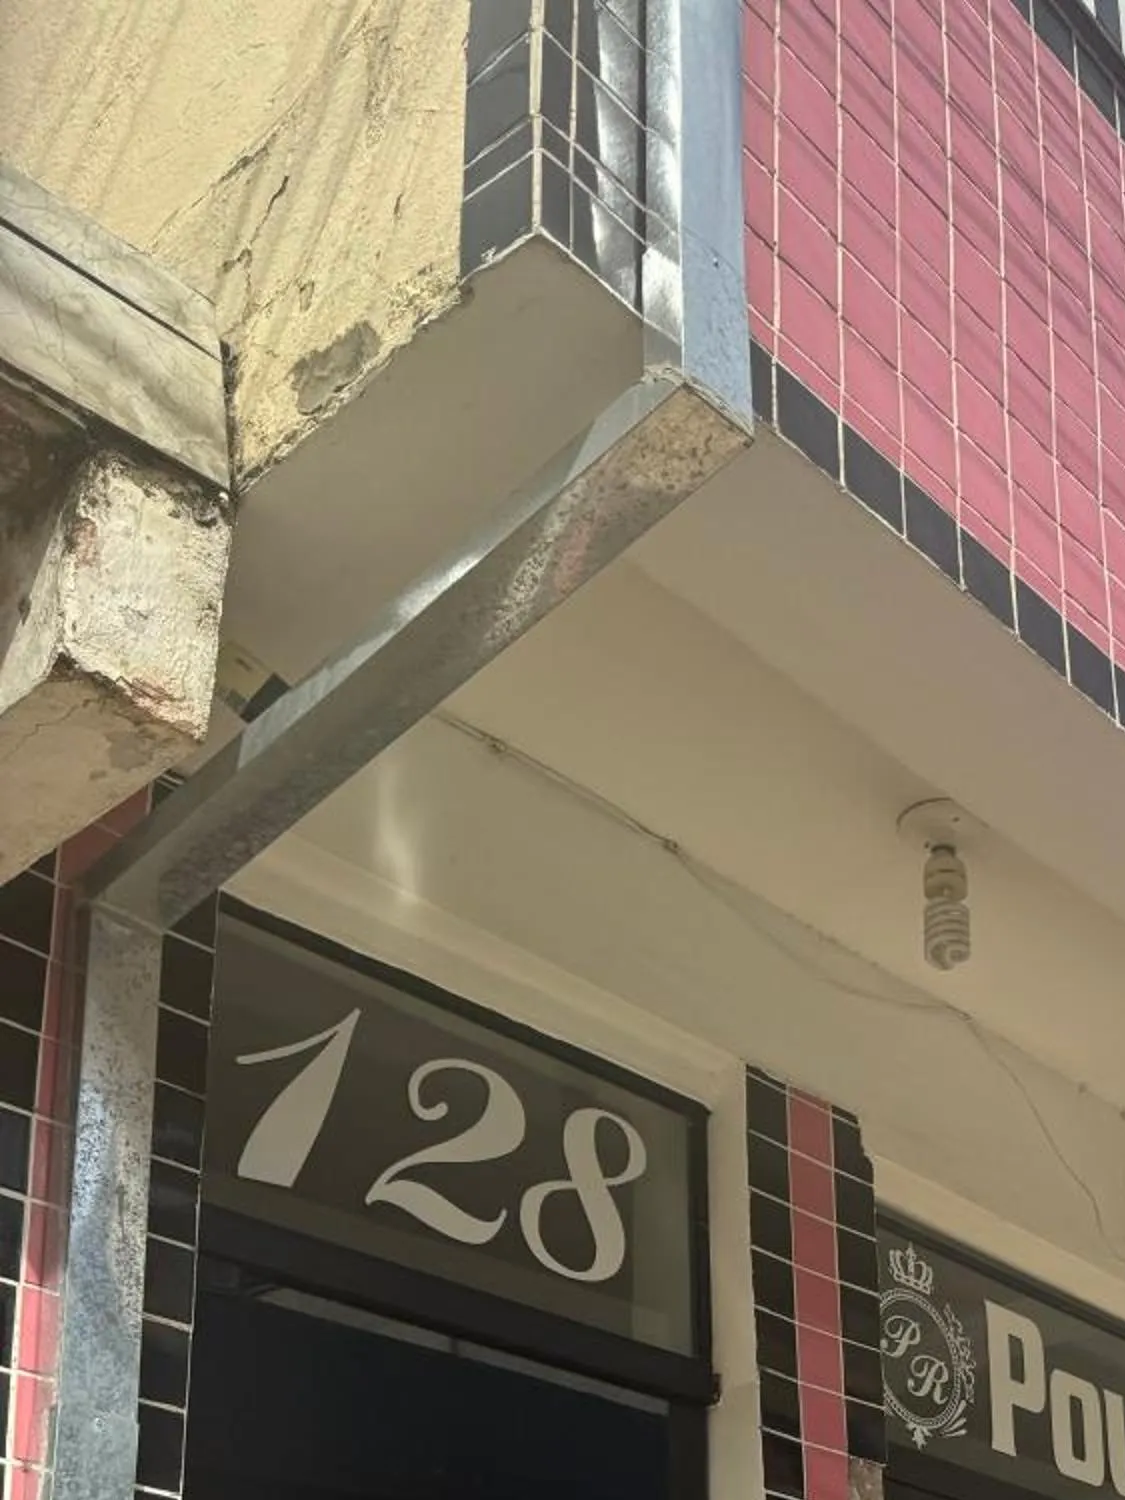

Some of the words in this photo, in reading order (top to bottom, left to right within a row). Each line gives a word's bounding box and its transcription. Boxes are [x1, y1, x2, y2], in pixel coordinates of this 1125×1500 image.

[236, 1008, 647, 1281] 128
[880, 1315, 921, 1358] P
[907, 1355, 949, 1405] R
